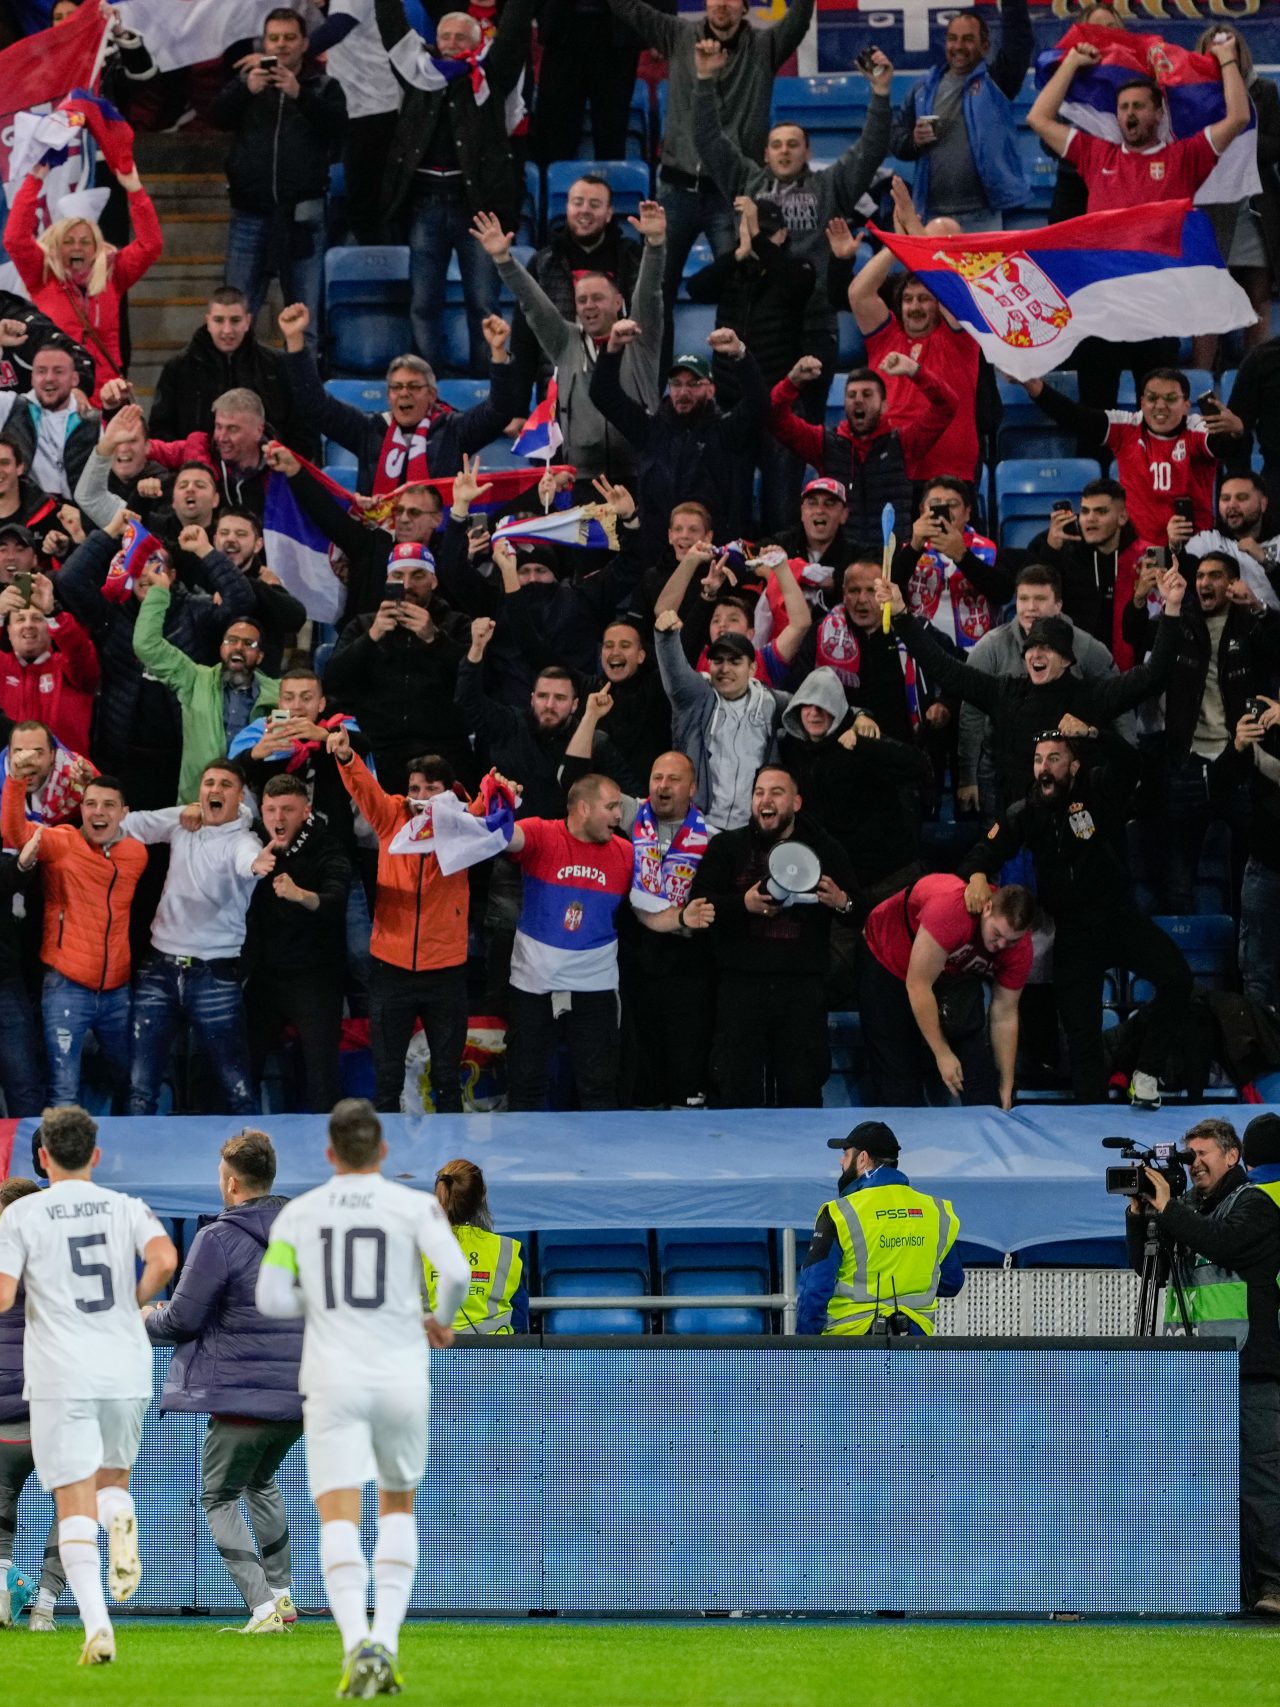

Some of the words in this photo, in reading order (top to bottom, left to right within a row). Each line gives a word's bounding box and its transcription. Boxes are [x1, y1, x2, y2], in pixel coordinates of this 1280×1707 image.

[1150, 462, 1172, 491] 10
[557, 865, 607, 887] СРБИЈА
[875, 1208, 908, 1220] PSS
[879, 1232, 926, 1251] Supervisor
[67, 1232, 115, 1314] 5
[320, 1226, 387, 1310] 10
[468, 1286, 485, 1296] ER
